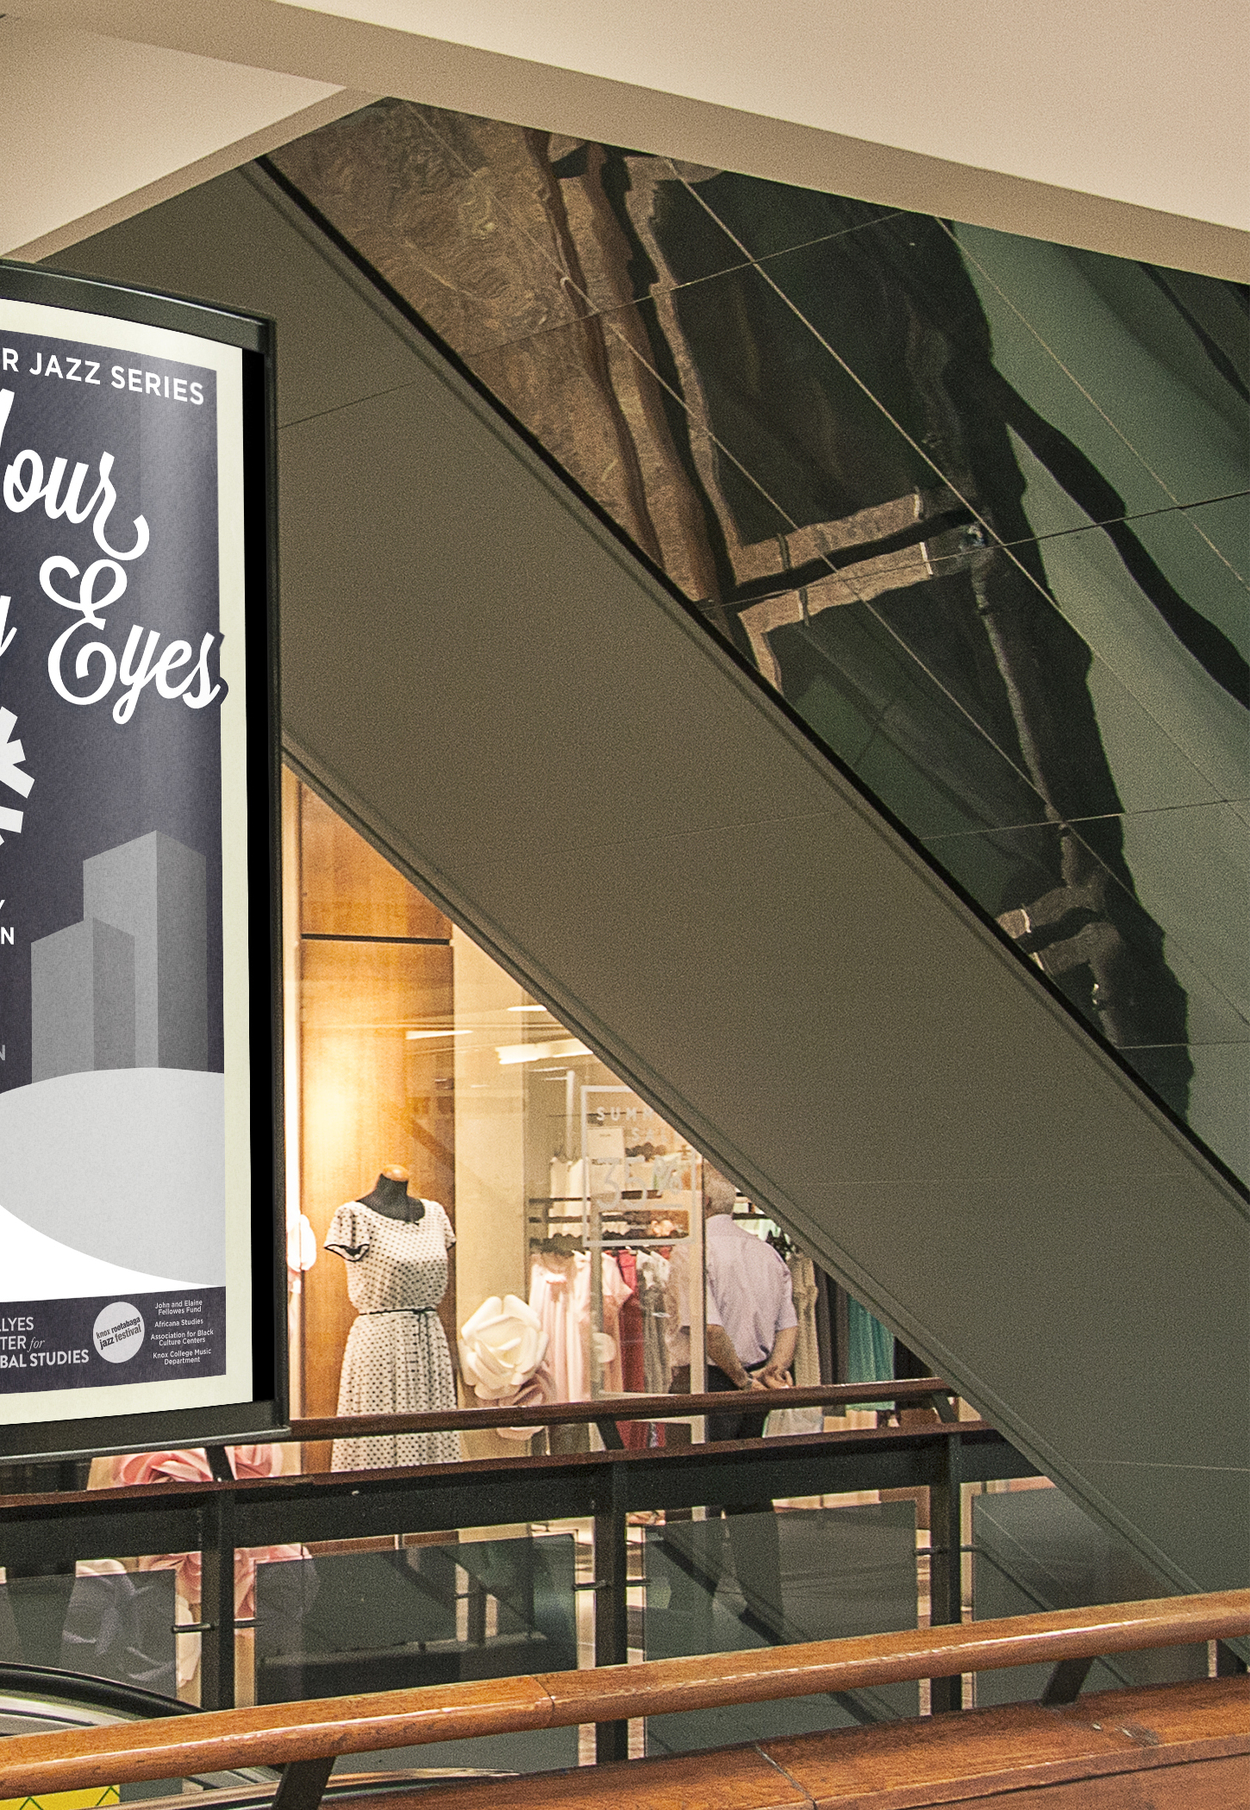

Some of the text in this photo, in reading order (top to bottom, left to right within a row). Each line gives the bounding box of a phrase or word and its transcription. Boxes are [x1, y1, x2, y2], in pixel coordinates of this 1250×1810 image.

[29, 353, 101, 385] JAZZ
[111, 366, 205, 405] SERIES
[39, 555, 222, 724] Eyes
[155, 1299, 203, 1309] John and Elaine
[154, 1318, 204, 1328] Africana Studies
[96, 1329, 111, 1340] knox
[99, 1324, 142, 1351] jazz festival
[151, 1332, 186, 1340] Association
[197, 1329, 214, 1337] Black
[28, 1337, 45, 1353] for
[30, 1349, 90, 1366] STUDIES
[194, 1348, 211, 1356] Music
[164, 1356, 201, 1365] Department
